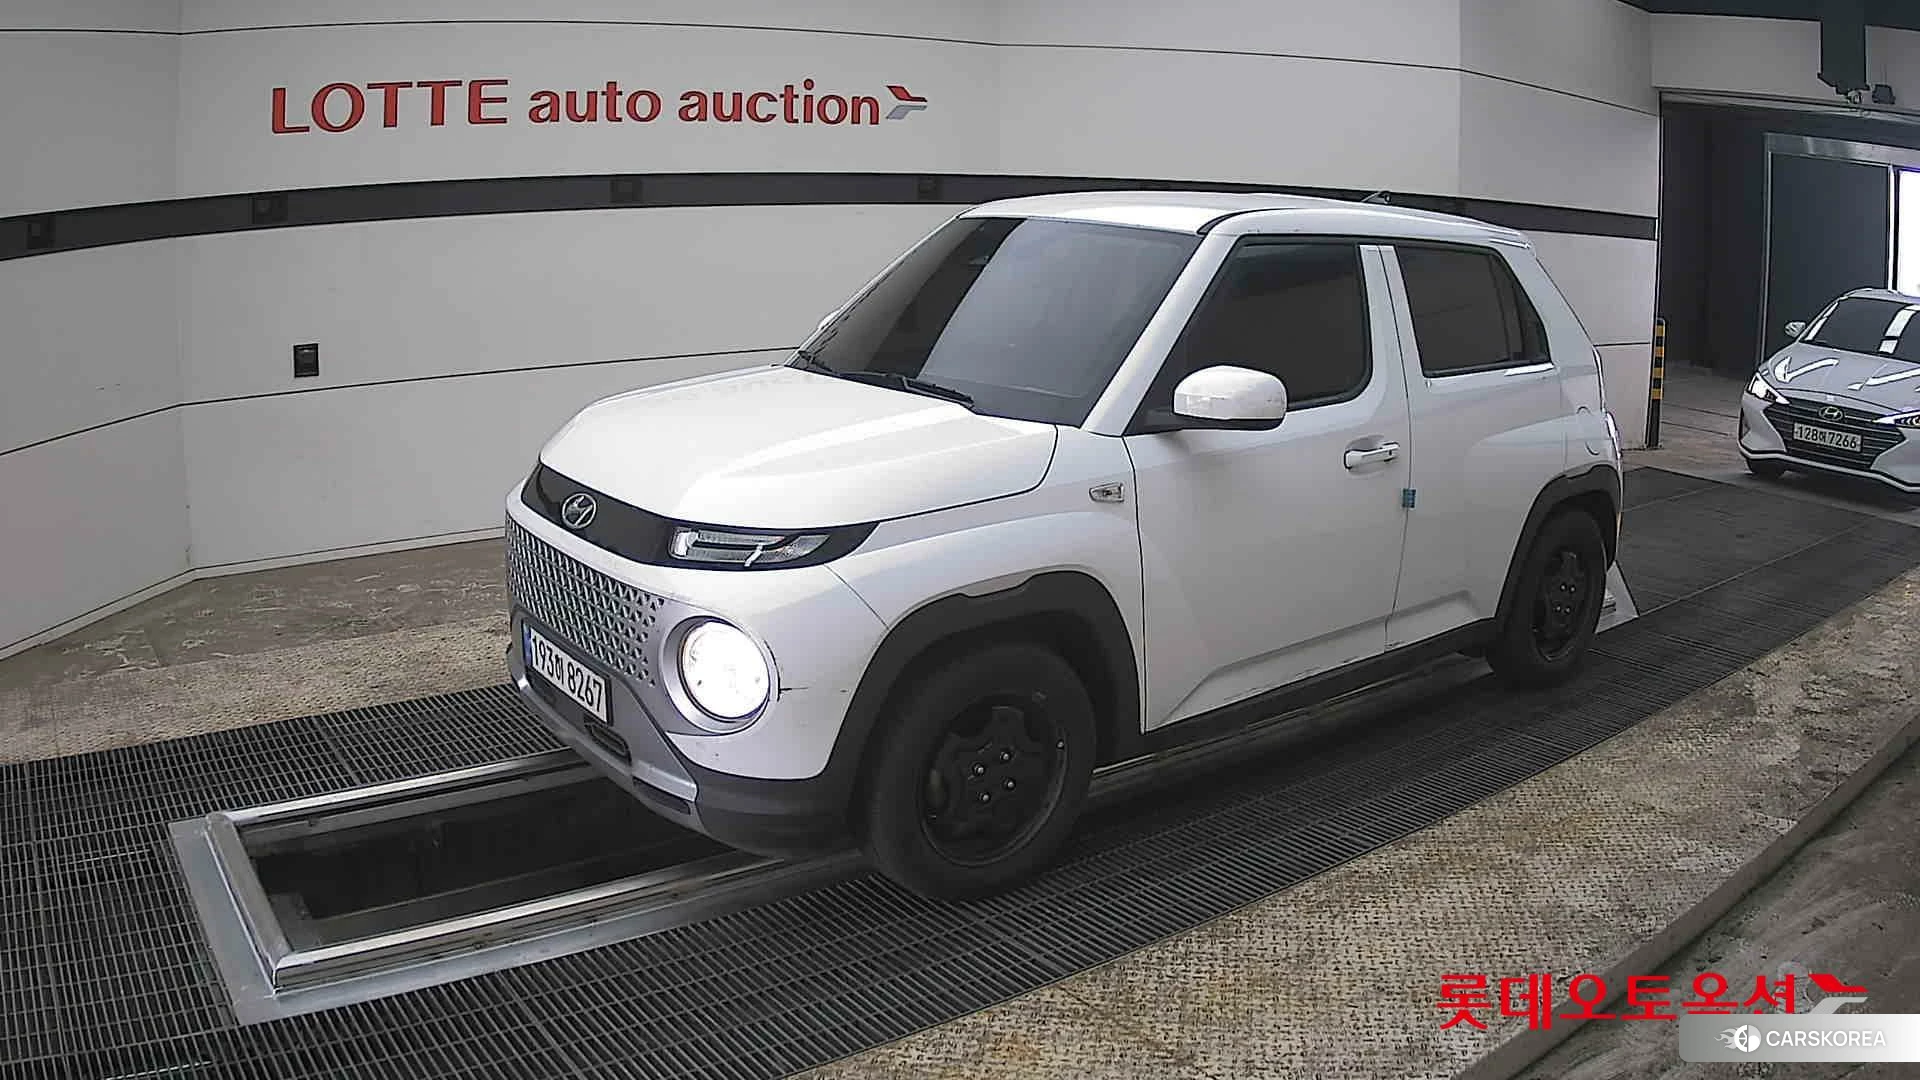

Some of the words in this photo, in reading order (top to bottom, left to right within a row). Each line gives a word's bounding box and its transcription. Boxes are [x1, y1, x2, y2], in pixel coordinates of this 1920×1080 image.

[271, 79, 508, 134] LOTTE
[527, 81, 662, 125] auto
[677, 79, 880, 126] auction
[567, 661, 603, 713] 8267
